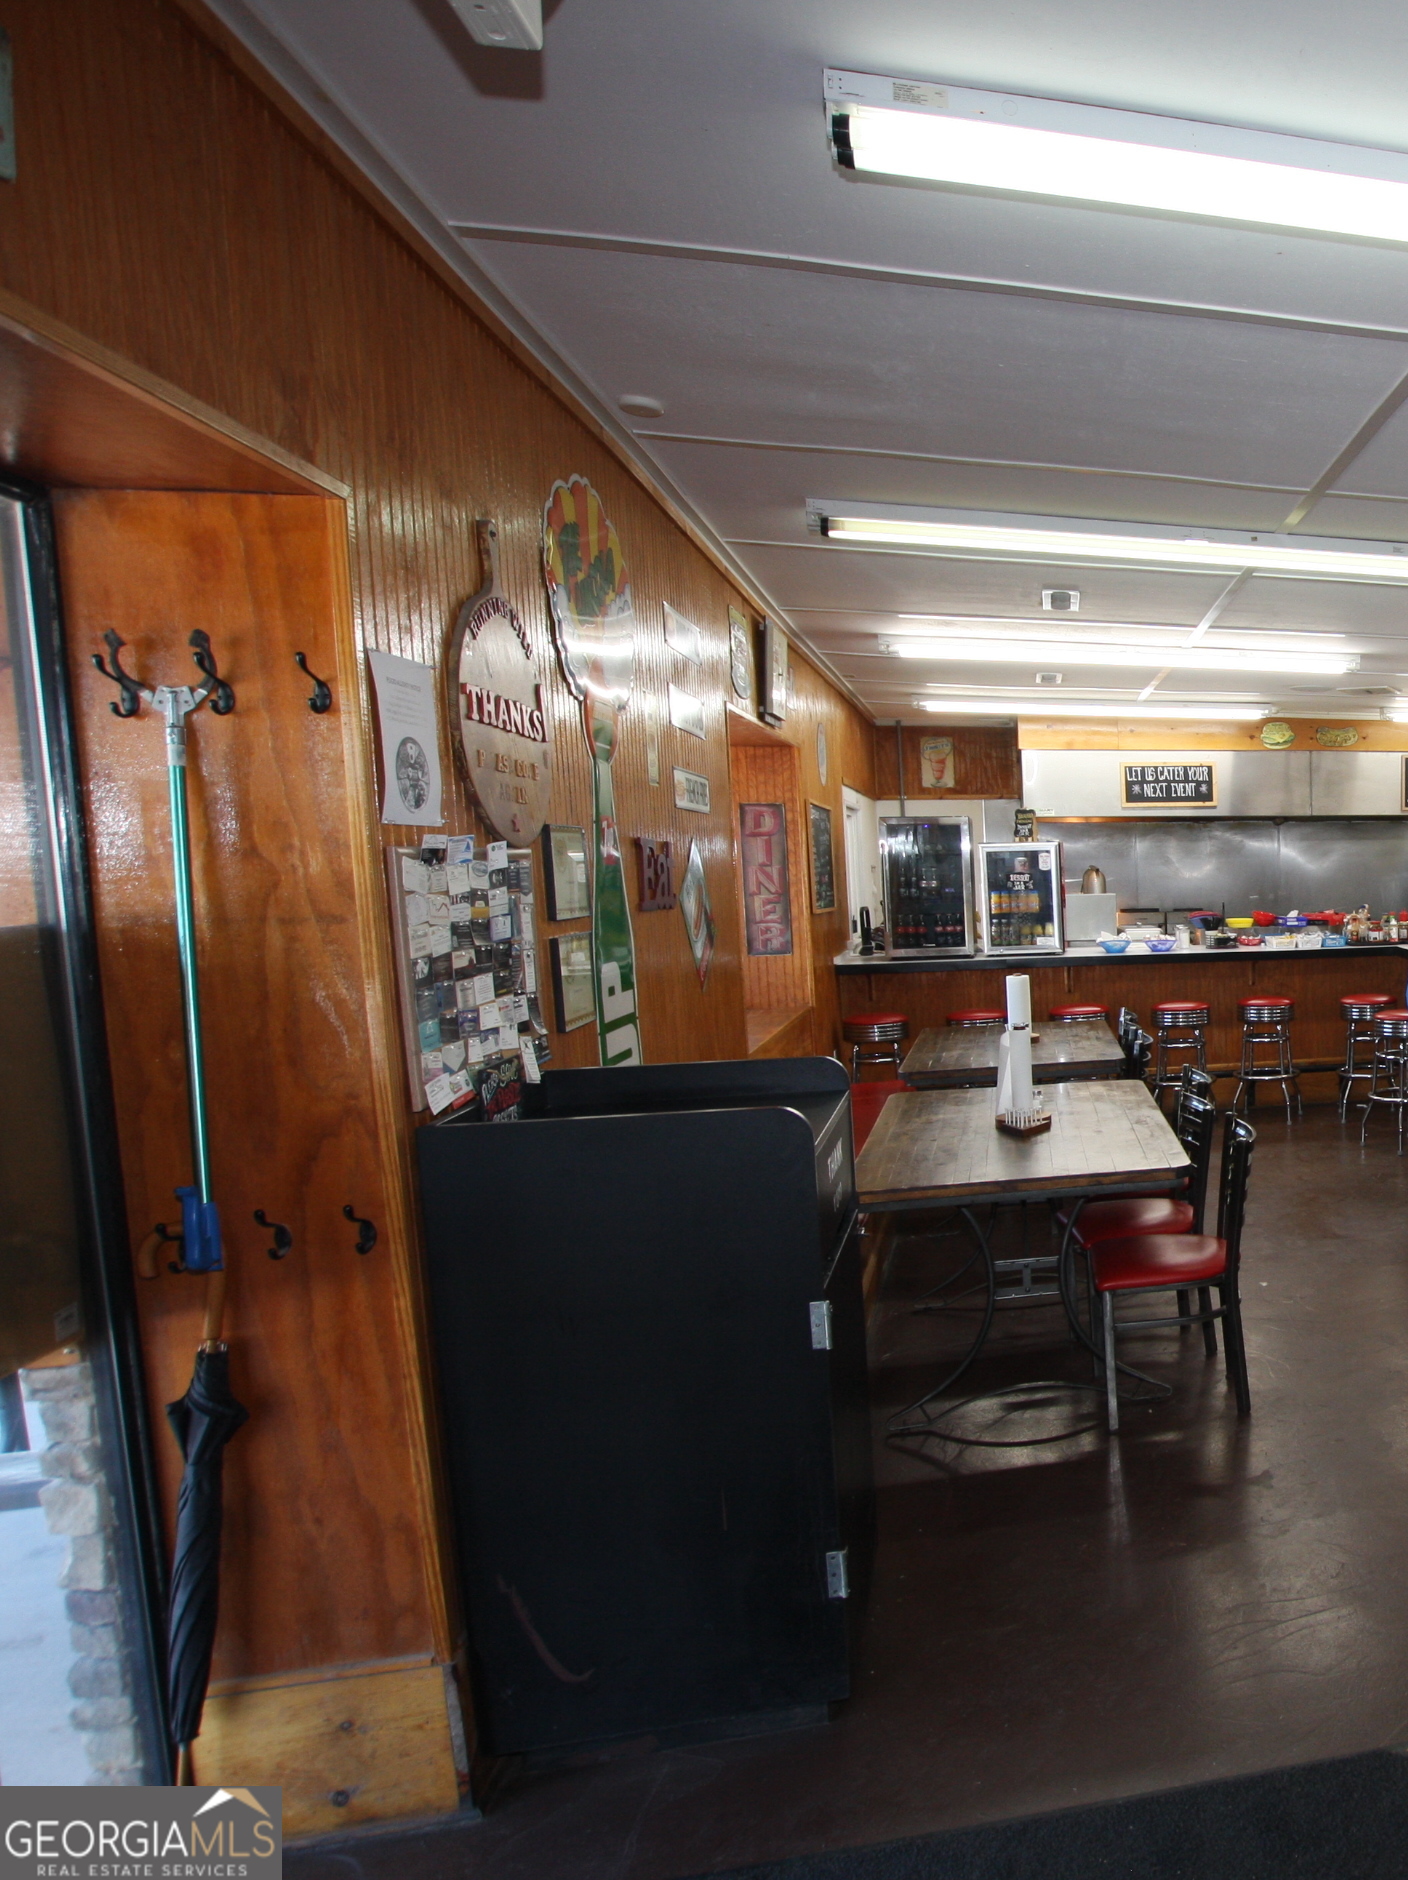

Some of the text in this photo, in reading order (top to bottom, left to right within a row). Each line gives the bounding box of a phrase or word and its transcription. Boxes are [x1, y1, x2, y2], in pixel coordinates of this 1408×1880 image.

[463, 686, 544, 741] THANKS
[1126, 766, 1209, 781] LET US CATER YOUR
[1143, 783, 1196, 797] NEXT EVENT
[743, 806, 786, 950] DINER
